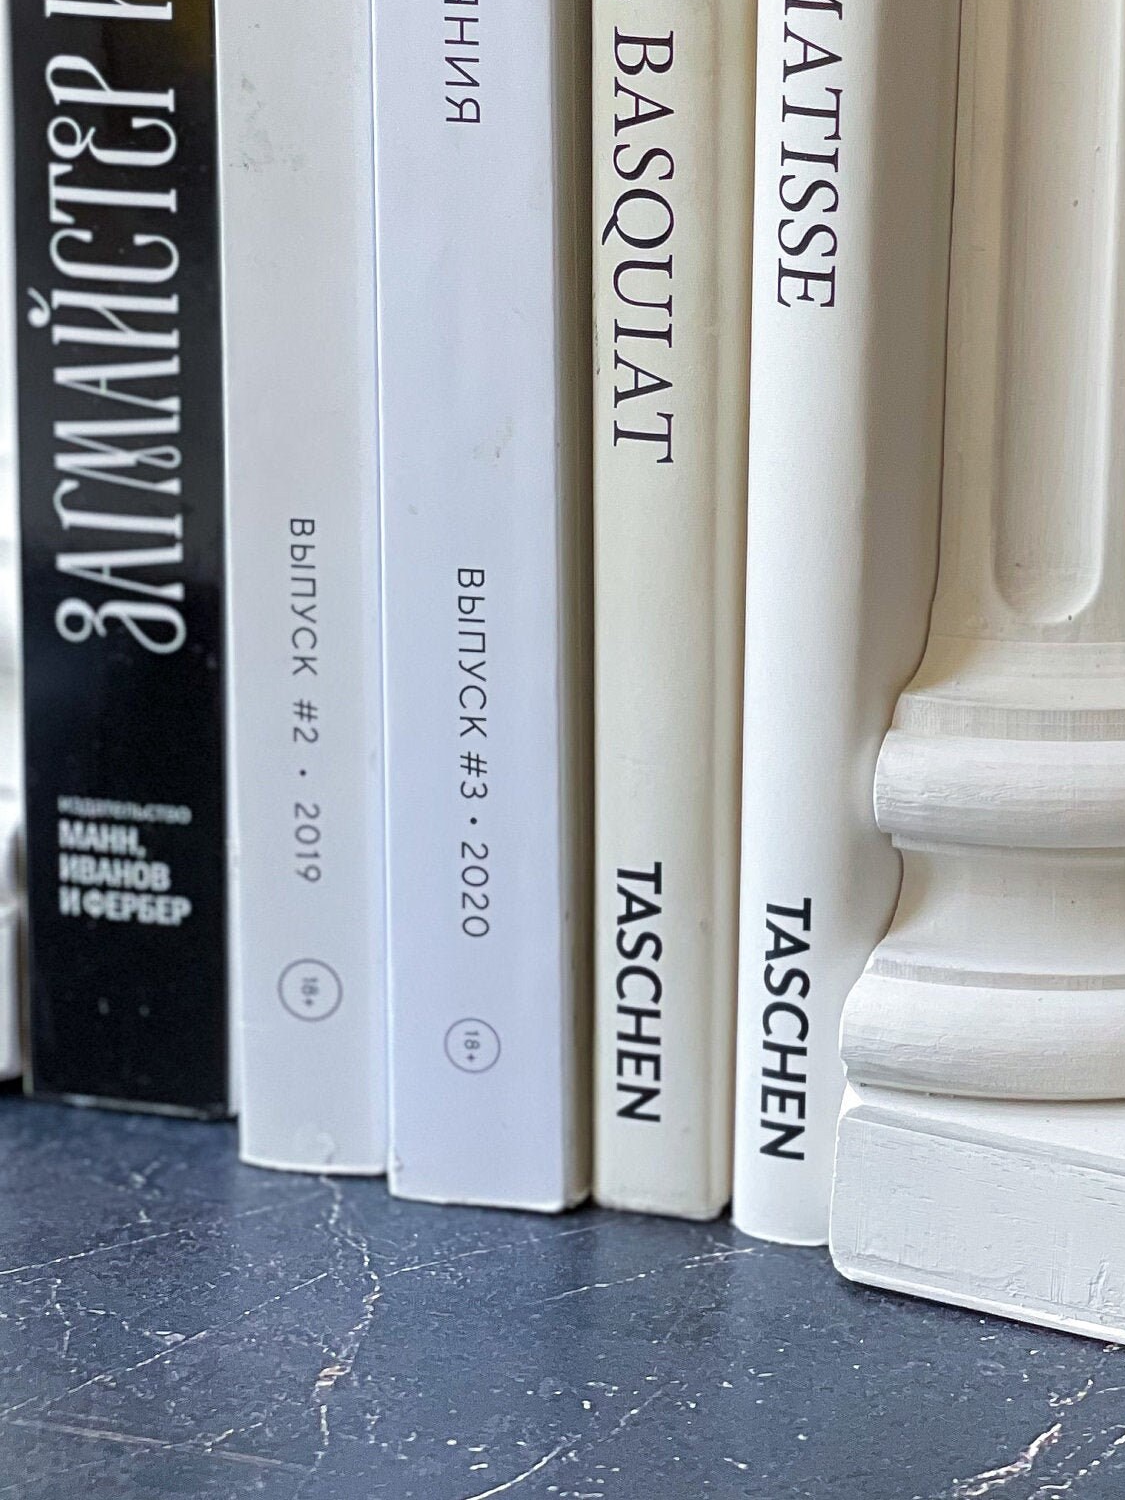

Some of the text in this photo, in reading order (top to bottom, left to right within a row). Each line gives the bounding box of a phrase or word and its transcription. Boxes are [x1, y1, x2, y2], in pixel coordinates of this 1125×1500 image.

[27, 54, 187, 655] ЗАГМАЙСТЕР
[601, 25, 676, 465] BASQUIAT
[289, 517, 322, 884] ВЫПУСК #2 2019
[457, 567, 490, 938] ВЫПУСК #3 2020
[58, 818, 147, 860] МАНН,
[58, 852, 172, 893] ИВАНОВ
[58, 885, 193, 927] И ФЕРБЕР
[463, 1029, 481, 1062] 18+
[614, 861, 663, 1123] TASCHEN
[759, 896, 812, 1161] TASCHEN
